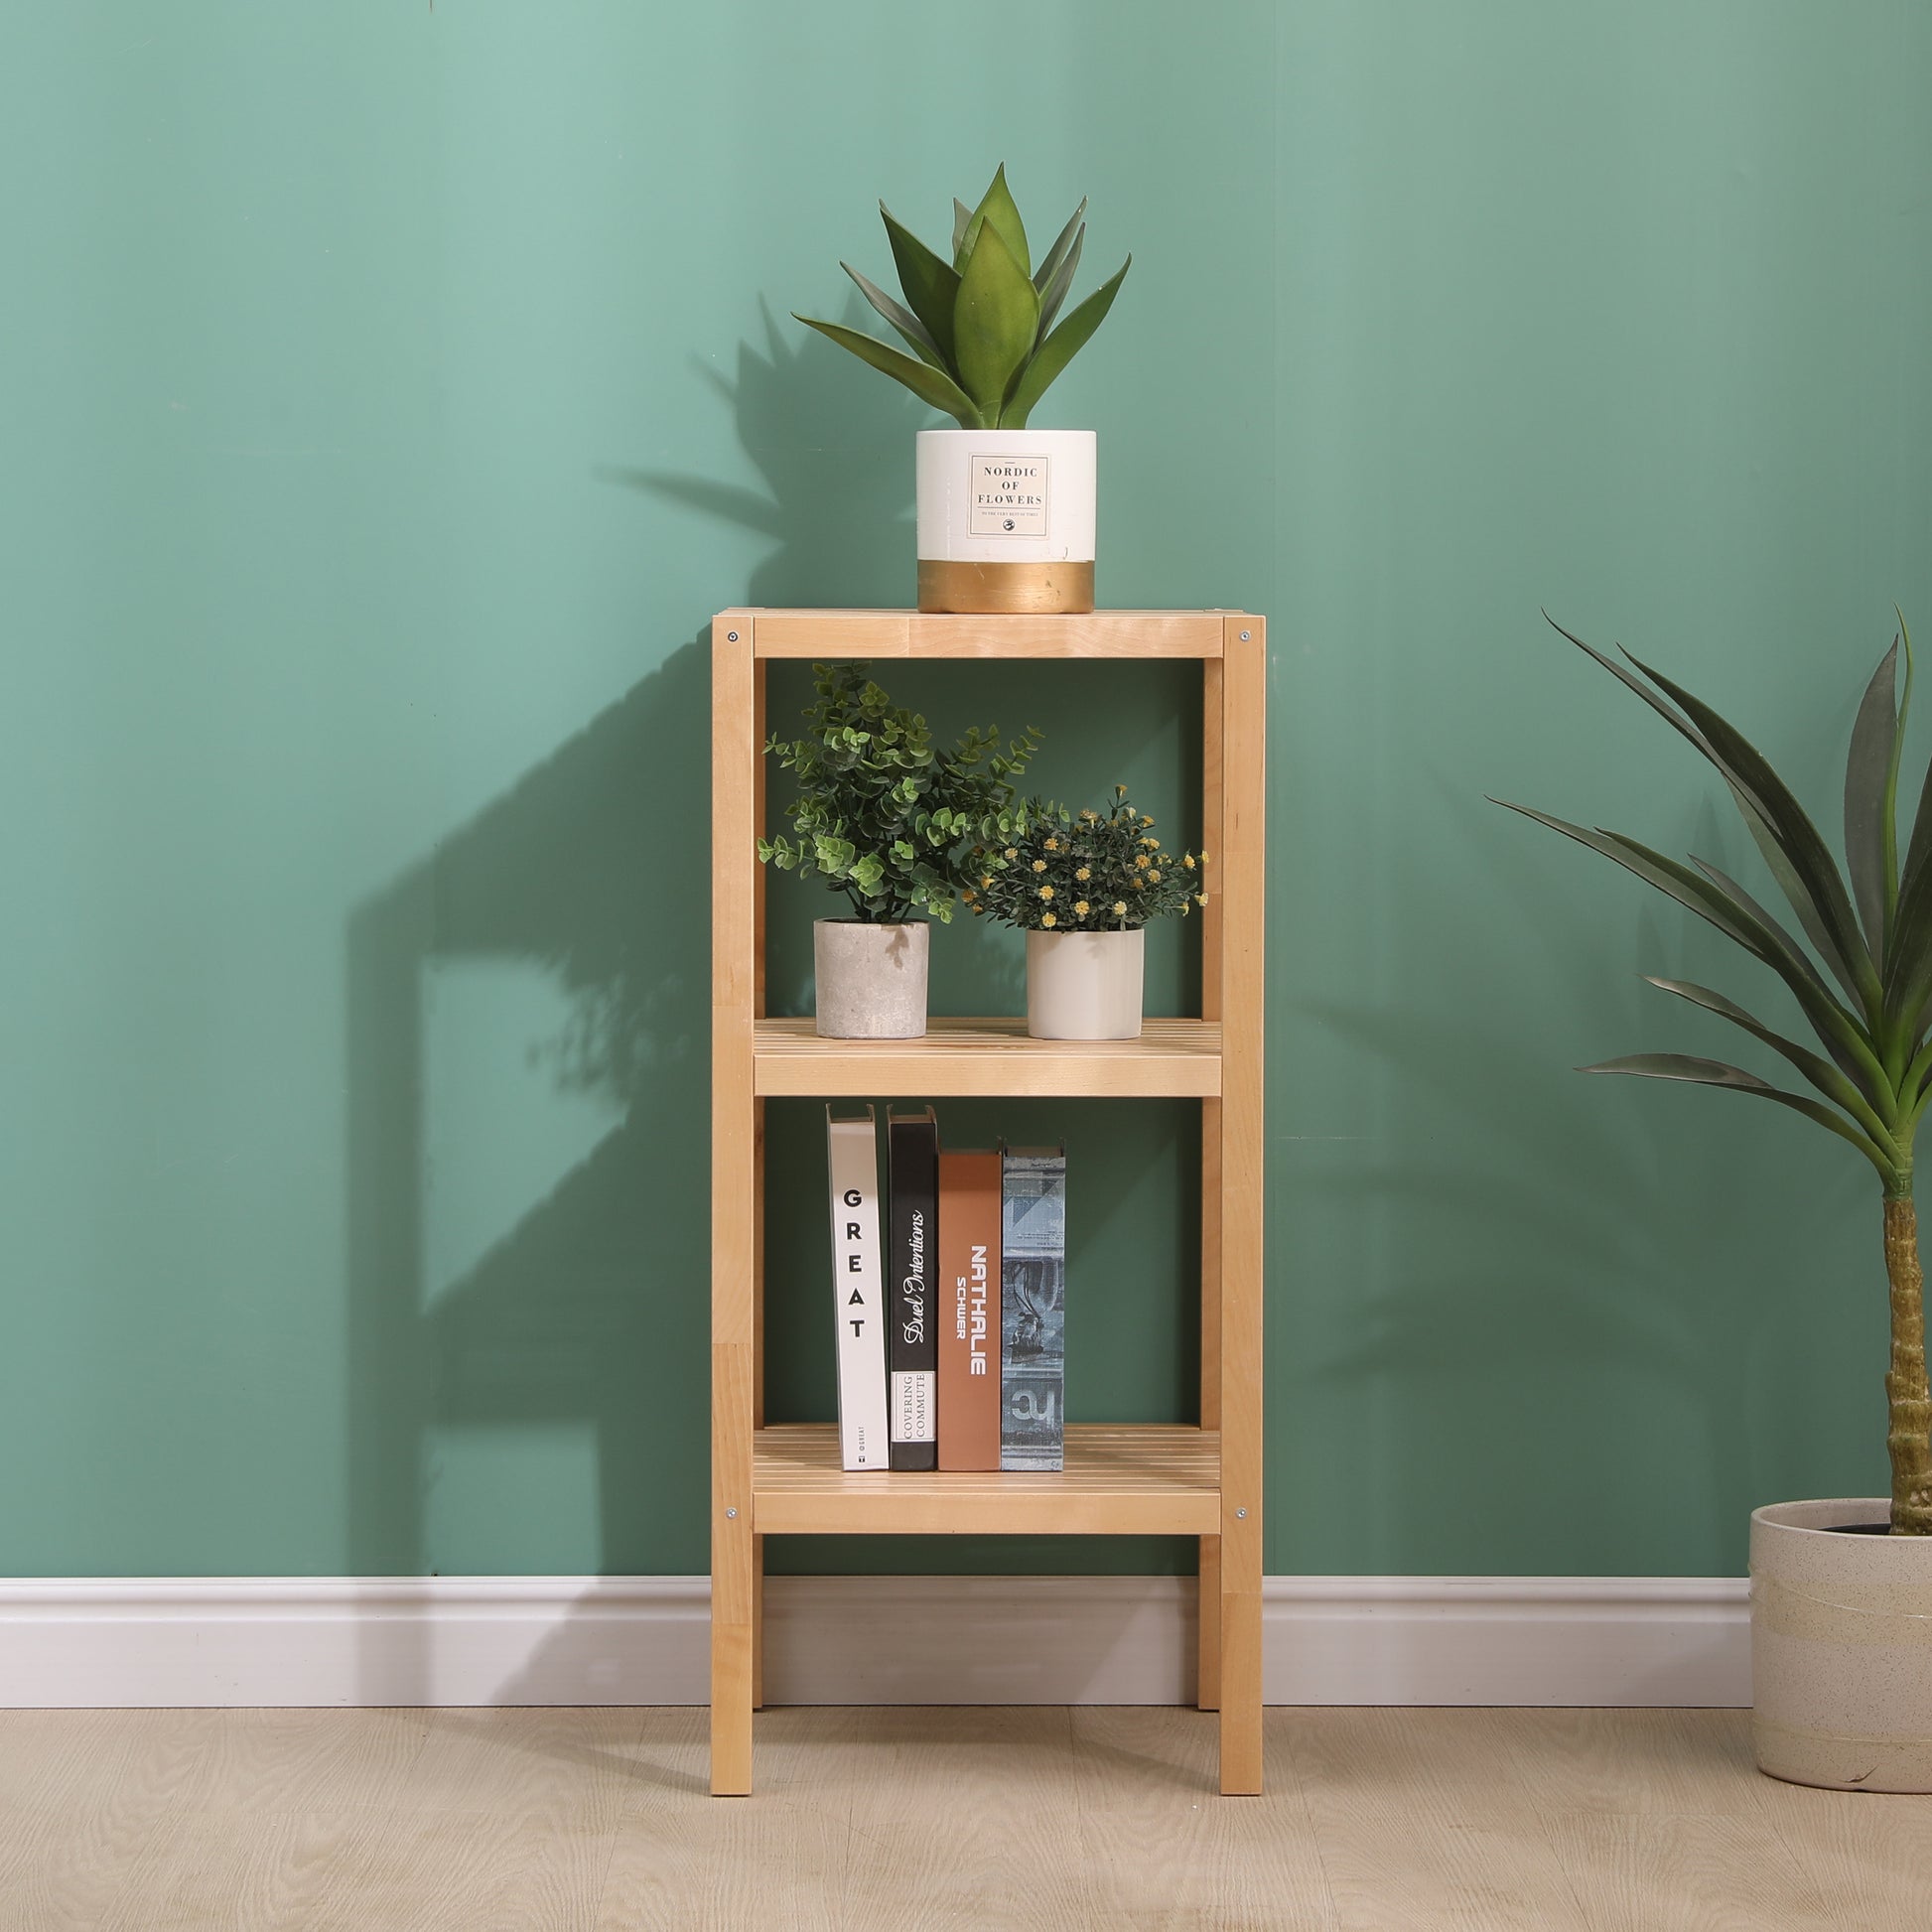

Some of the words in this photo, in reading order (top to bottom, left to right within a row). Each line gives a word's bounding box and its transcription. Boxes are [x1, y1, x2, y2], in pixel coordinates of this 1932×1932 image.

[978, 494, 1041, 504] FLOWERS
[984, 467, 1037, 477] NORDIC
[1002, 481, 1019, 490] OF
[844, 1189, 865, 1337] GREAT
[902, 1209, 925, 1295] Intentions
[902, 1295, 924, 1344] Duel
[956, 1276, 967, 1340] SCHWER
[970, 1245, 987, 1375] NATHALIE
[903, 1376, 912, 1440] COVERING
[916, 1373, 925, 1438] COMMUTE
